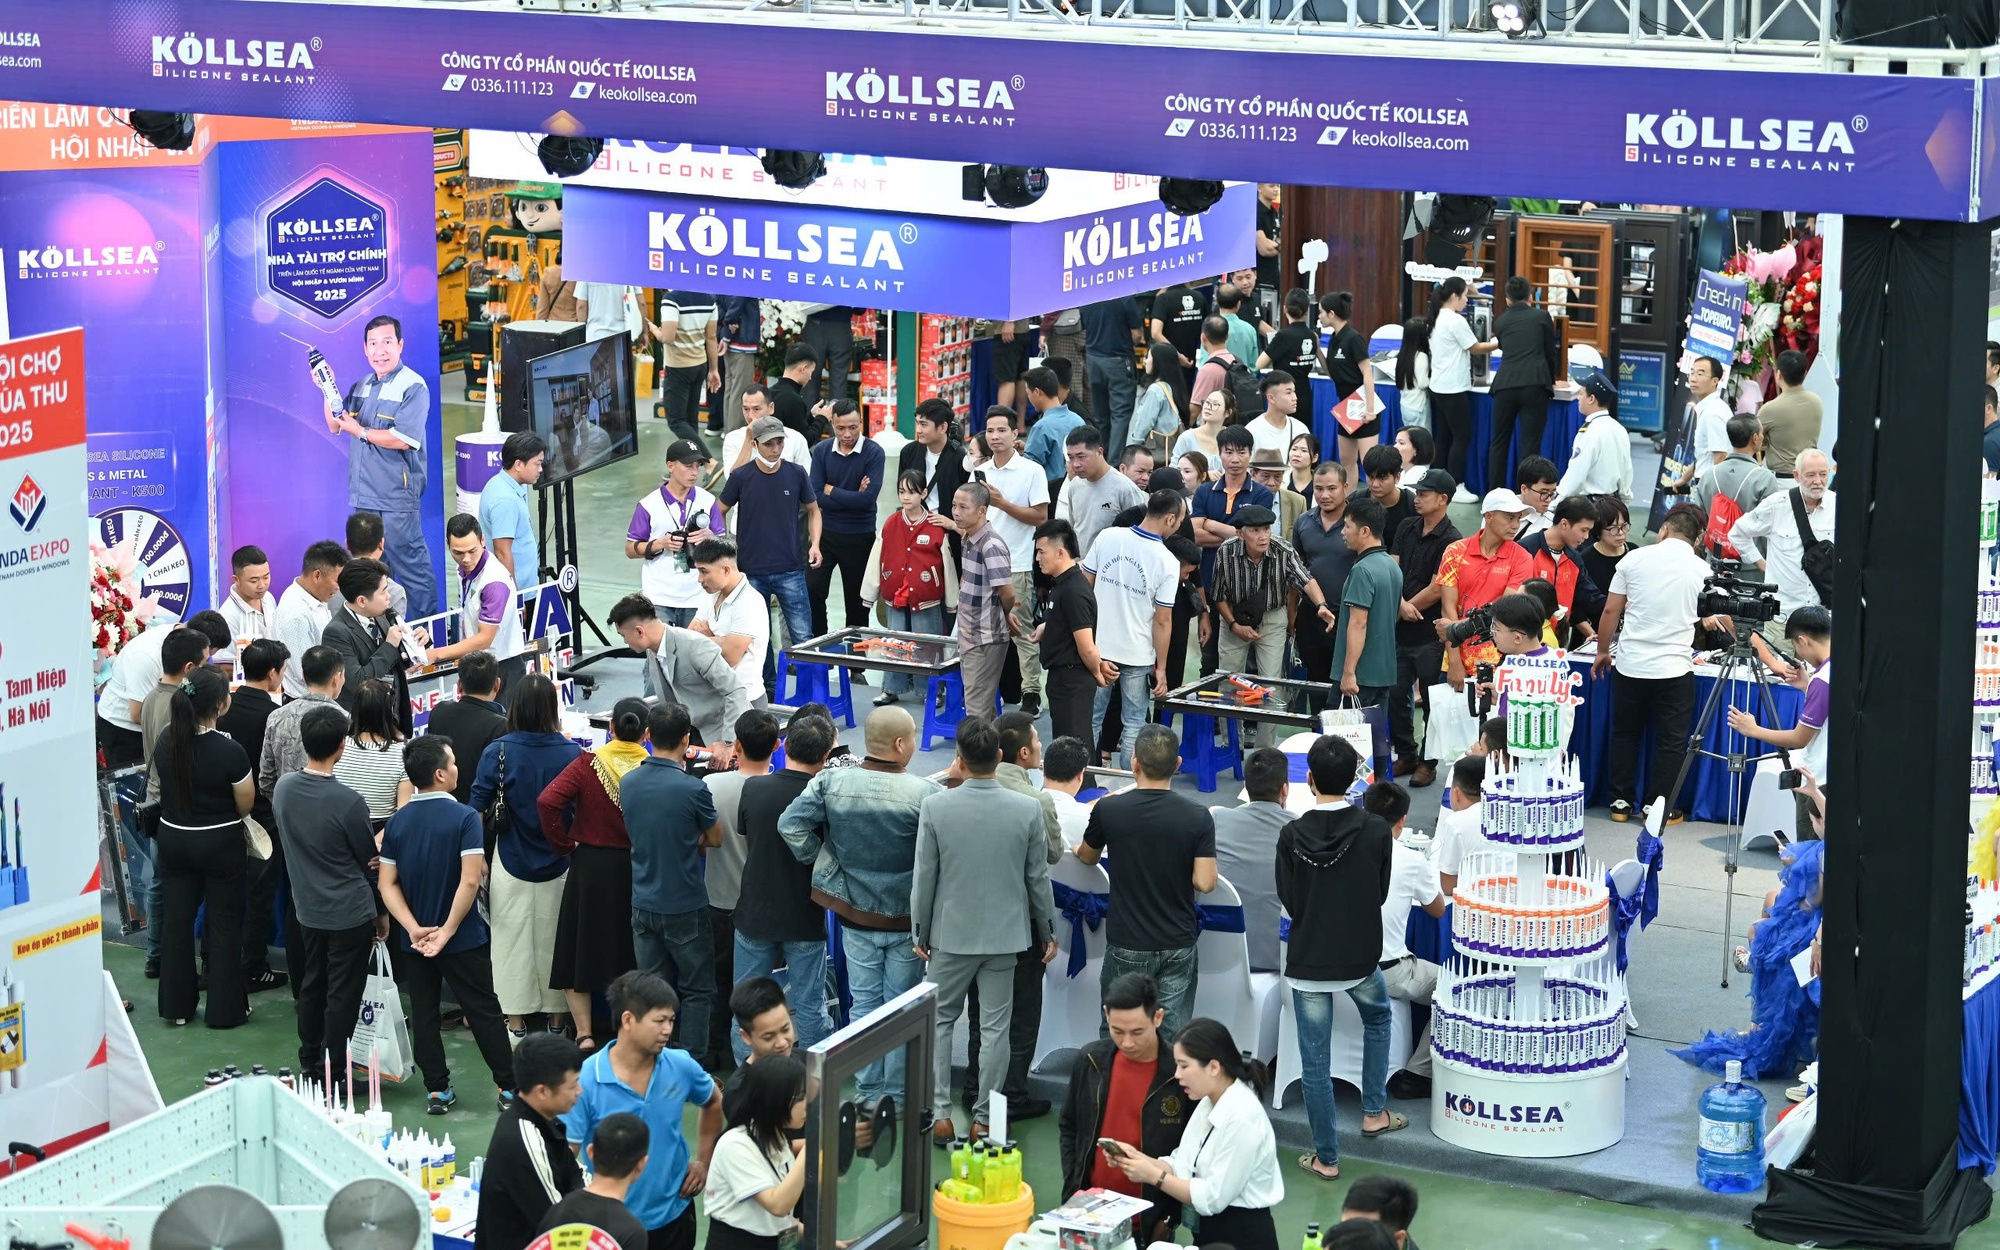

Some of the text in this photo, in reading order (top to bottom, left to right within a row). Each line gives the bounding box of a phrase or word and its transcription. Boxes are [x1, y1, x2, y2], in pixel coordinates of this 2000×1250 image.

[152, 63, 315, 85] SILICONE SEALANT
[441, 51, 696, 82] CÔNG TY CỔ PHẦN QUỐC TẾ KOLLSEA
[471, 78, 697, 104] 0336.111.123 keokollsea.com
[826, 101, 1015, 127] SILICONE SEALANT
[1164, 93, 1469, 126] CÔNG TY CỔ PHẦN QUỐC TẾ KOLLSEA
[51, 134, 89, 161] HỘI
[1199, 122, 1469, 151] 0336.111.123 keokollsea.com
[1625, 145, 1855, 172] SILICONE SEALANT
[332, 233, 375, 241] SEALANT
[267, 247, 387, 266] NHÀ TÀI TRỢ CHÍNH
[19, 268, 159, 279] SILICONE SEALANT
[649, 252, 904, 292] SILICONE SEALANT
[1063, 252, 1204, 292] SILICONE SEALANT
[314, 289, 347, 301] 2025
[1698, 279, 1742, 312] Check in
[1701, 306, 1732, 331] TOPEURO
[0, 346, 62, 385] ỘI CHỢ
[0, 380, 68, 414] ÙA THU
[0, 420, 33, 447] 025
[112, 448, 166, 461] SILICONE
[88, 469, 148, 481] S & METAL
[131, 484, 165, 497] K500
[16, 567, 36, 578] DOORS
[42, 559, 70, 571] WINDOWS
[153, 567, 171, 578] CHAI
[171, 559, 185, 570] KEO
[6, 668, 67, 698] Tam Hiệp
[8, 699, 51, 728] Hà Nội
[17, 944, 30, 955] Keo
[42, 935, 54, 948] góc
[56, 932, 60, 942] 2
[62, 926, 80, 940] thành
[1445, 1108, 1564, 1133] SILICONE SEALANT
